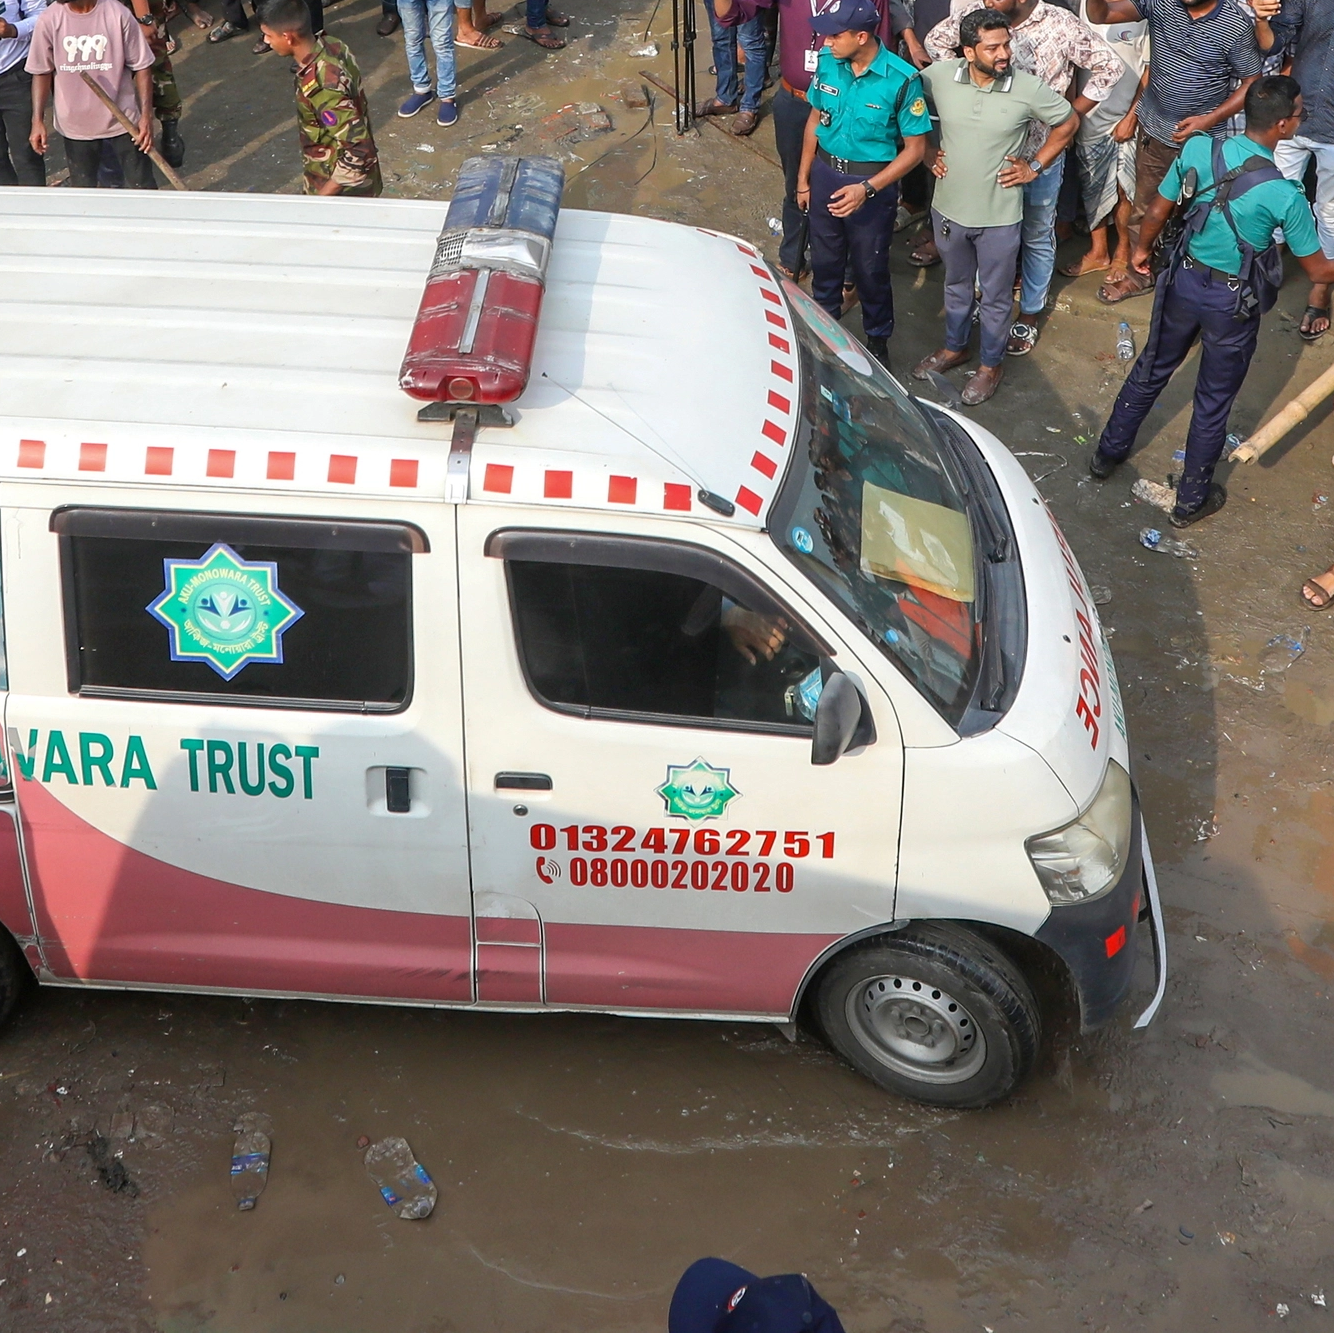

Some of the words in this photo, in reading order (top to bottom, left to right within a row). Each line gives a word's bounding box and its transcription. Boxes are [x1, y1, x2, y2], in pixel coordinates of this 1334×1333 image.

[177, 567, 249, 605] AKIJ-MONOWARA
[248, 578, 272, 607] TRUST
[179, 737, 321, 800] TRUST
[529, 823, 836, 860] 01324762751
[569, 857, 796, 894] 08000202020
